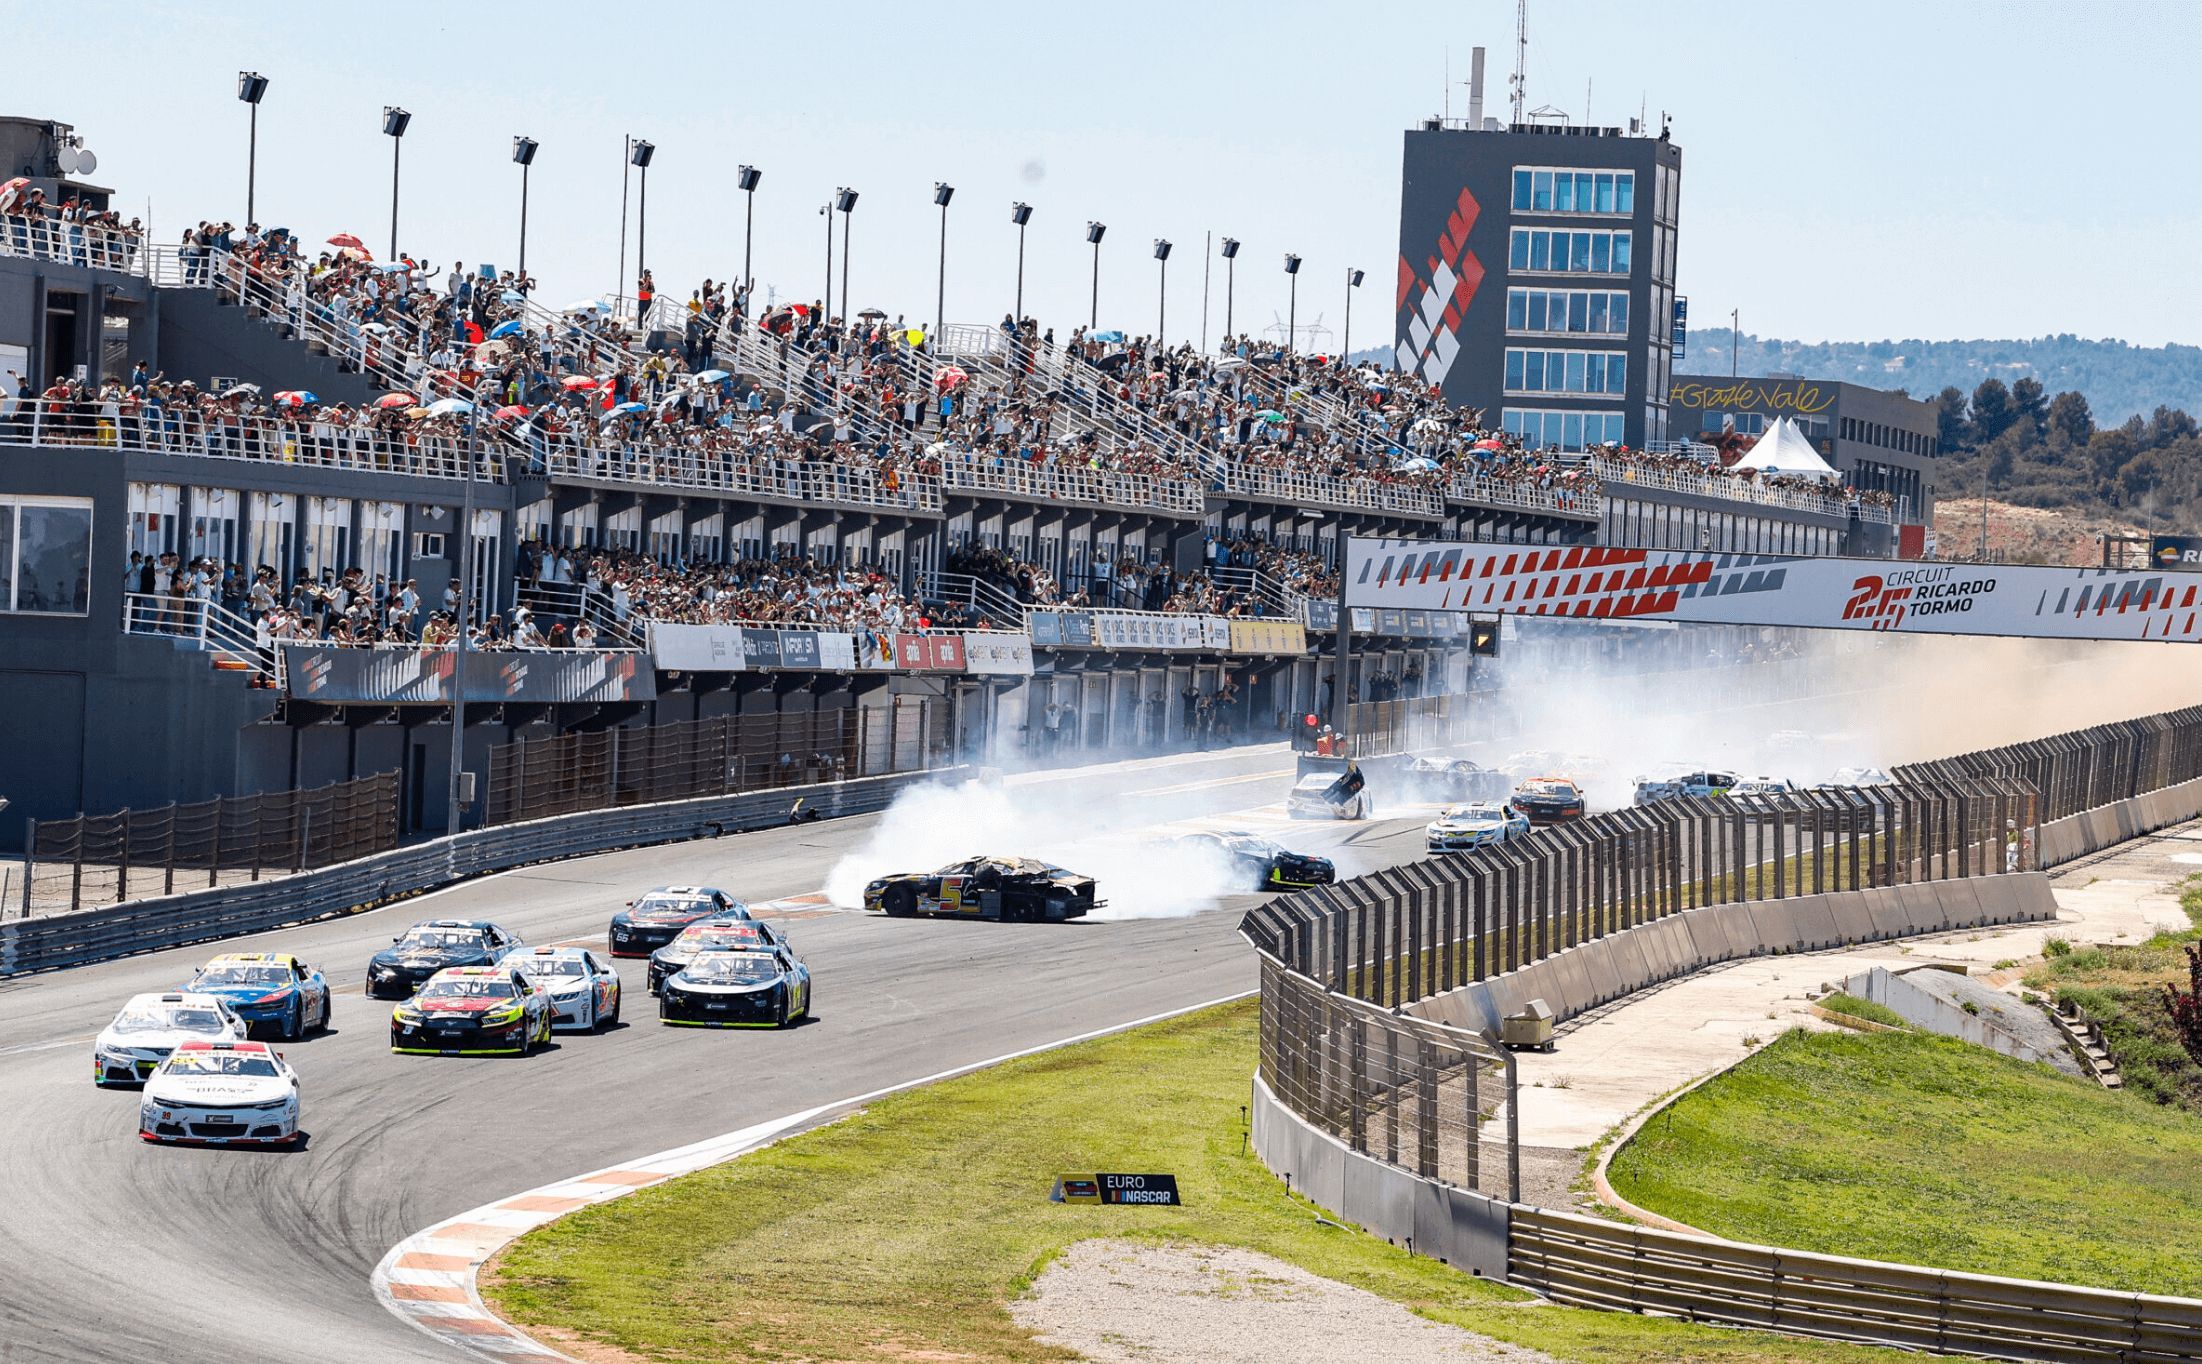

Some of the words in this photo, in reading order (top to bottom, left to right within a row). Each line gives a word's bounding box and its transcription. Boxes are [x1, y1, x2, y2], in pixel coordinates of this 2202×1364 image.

[1887, 566, 1955, 587] CIRCUIT
[1916, 578, 1996, 600] RICARDO
[1910, 598, 1973, 617] TORMO
[939, 877, 964, 911] 5
[1107, 1175, 1145, 1188] EURO
[1126, 1190, 1171, 1203] NASCAR
